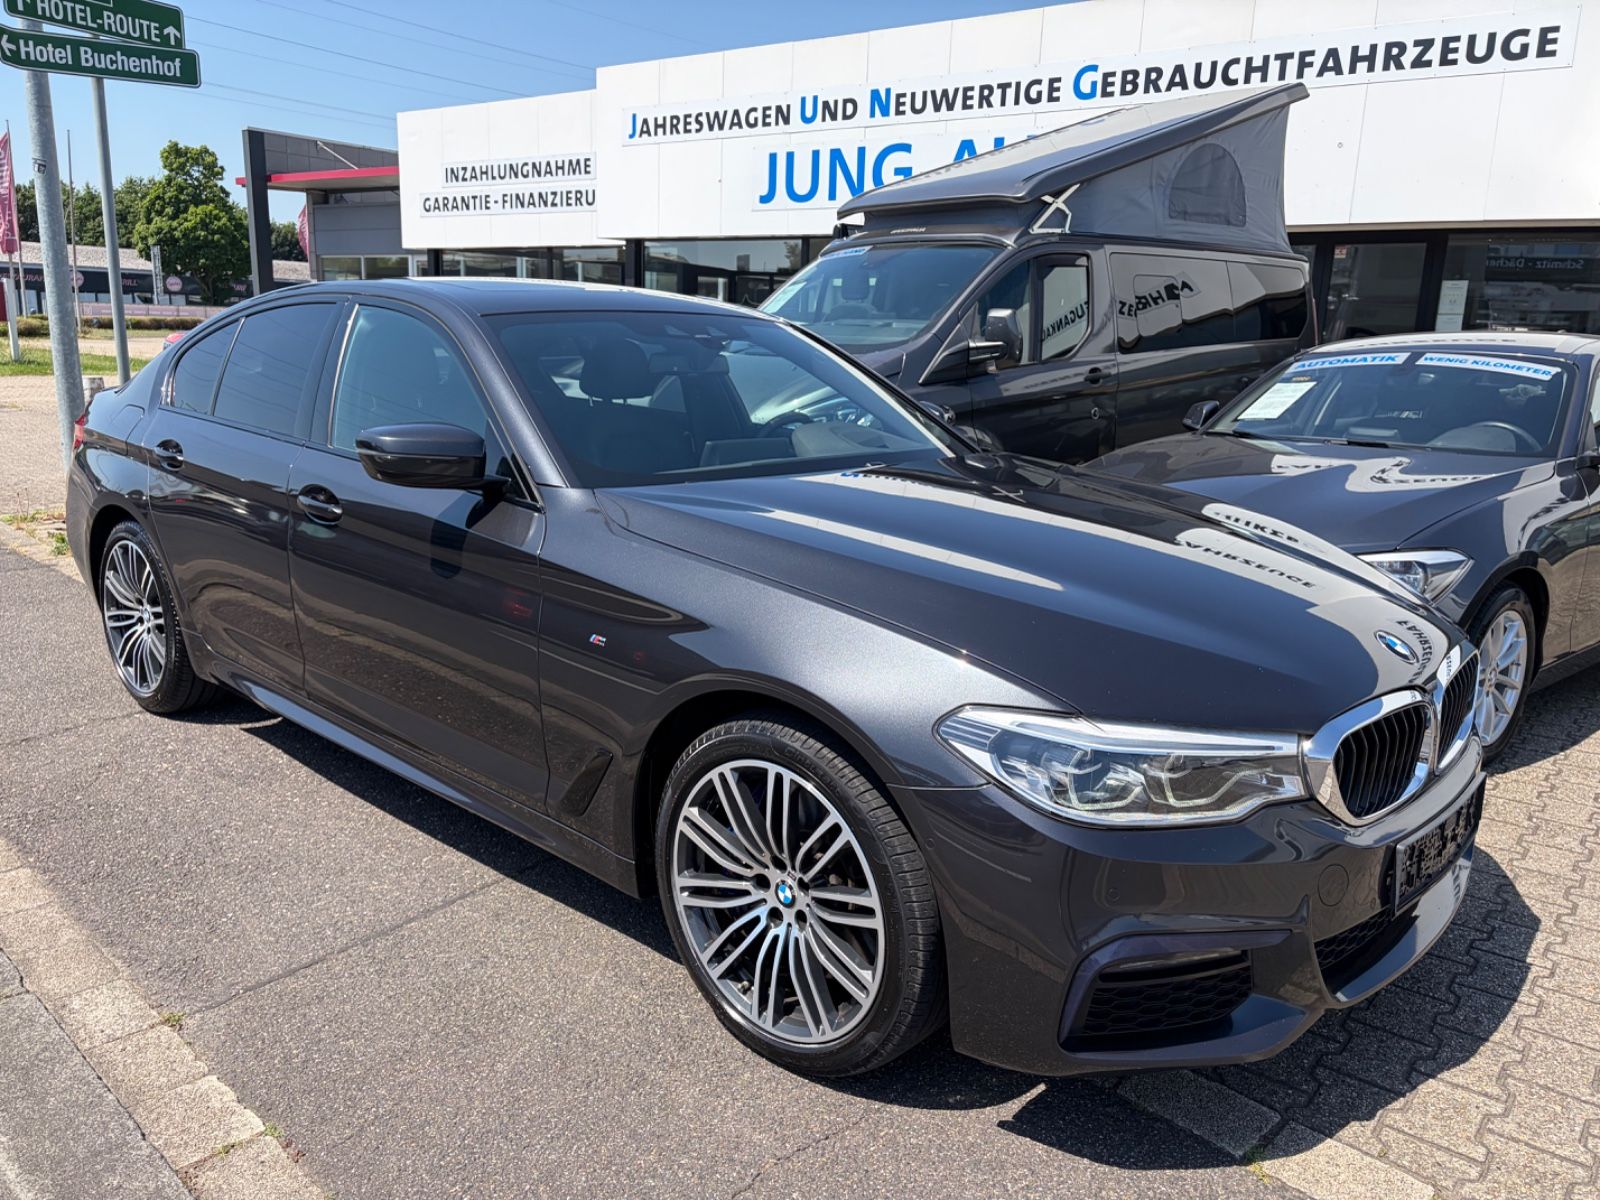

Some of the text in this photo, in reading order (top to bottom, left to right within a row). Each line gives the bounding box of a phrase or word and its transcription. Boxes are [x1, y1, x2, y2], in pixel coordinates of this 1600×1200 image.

[37, 0, 161, 42] HOTEL-ROUTE
[19, 39, 182, 77] Hotel Buchenhof
[628, 25, 1561, 139] JAHRESWAGEN UND NEUWERTIGE GEBRAUCHTFAHRZEUGE
[445, 158, 591, 183] INZAHLUNGNAHME
[759, 143, 913, 205] JUNG
[1297, 354, 1400, 370] AUTOMATIK
[1423, 355, 1553, 377] WENIG KILOMETER
